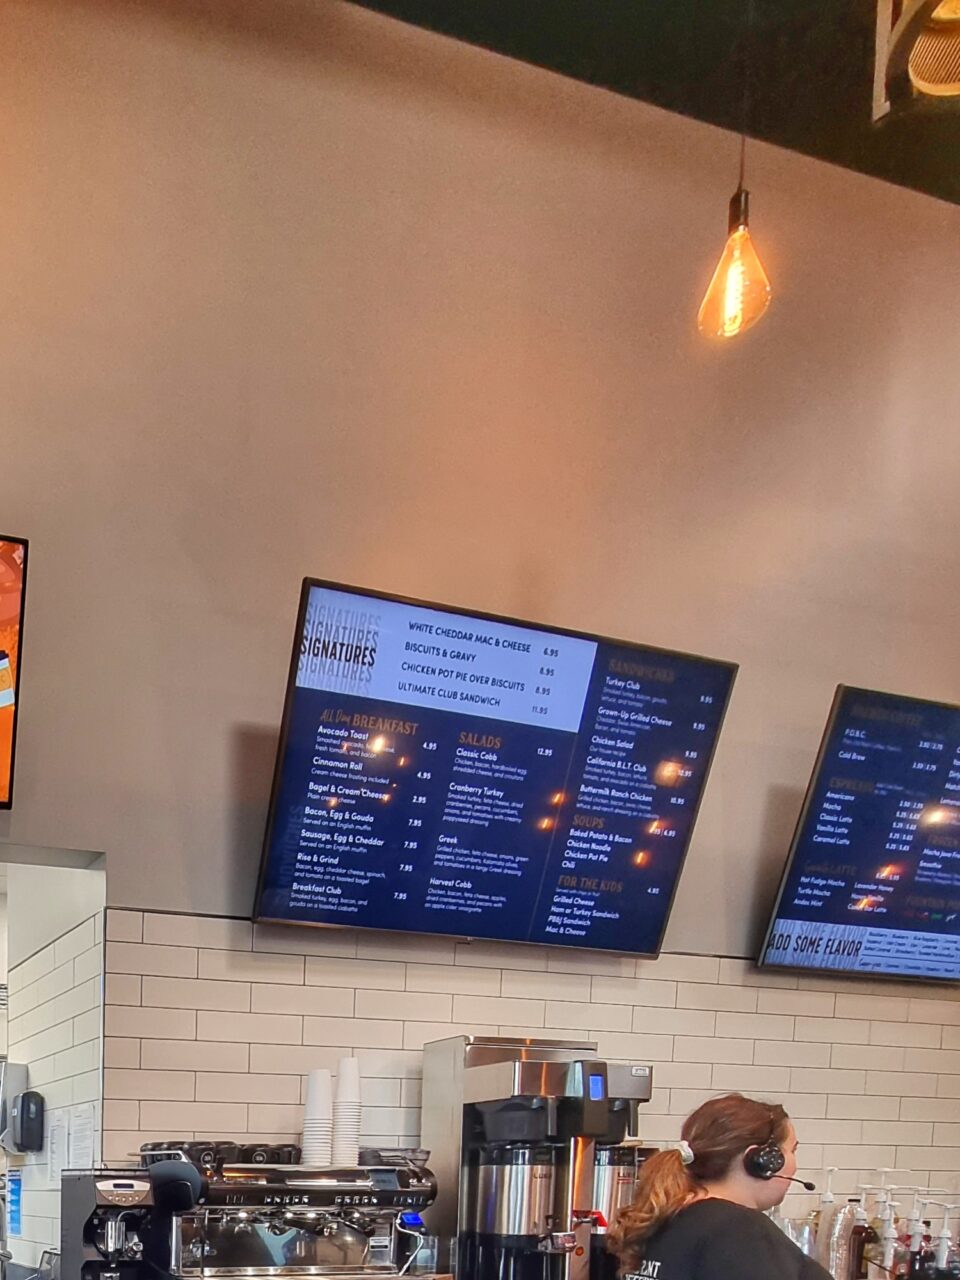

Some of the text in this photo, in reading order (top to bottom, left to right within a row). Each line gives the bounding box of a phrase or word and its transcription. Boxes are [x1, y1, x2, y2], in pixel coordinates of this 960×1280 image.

[304, 619, 379, 648] SIGNATURES
[409, 621, 559, 657] WHITE CHEDDAR MAC & CHEESE 6.95
[300, 636, 376, 667] SIGNATURES
[405, 641, 441, 656] BISCUITS
[442, 649, 447, 657] &
[449, 650, 476, 662] GRAVY
[298, 654, 373, 682] SIGNATURES
[402, 662, 437, 676] CHICKEN
[438, 668, 454, 679] POT
[456, 671, 468, 682] PIE
[469, 674, 490, 685] OVER
[491, 677, 526, 691] BISCUITS
[606, 676, 640, 690] Turkey Club
[398, 681, 436, 696] ULTIMATE
[437, 688, 458, 700] CLUB
[459, 693, 501, 707] SANDWICH
[598, 706, 629, 720] Grown-Up
[630, 712, 650, 723] Grilled
[651, 716, 672, 727] Cheese
[352, 714, 419, 736] BREAKFAST
[318, 725, 437, 750] Avocado Toast 4.95
[459, 731, 502, 749] SALADS
[592, 735, 634, 749] Chicken Salad
[456, 748, 552, 761] Classic Cobb 12.95
[838, 751, 851, 759] Cold
[313, 756, 431, 780] Cinnamon Roll 4.95
[586, 756, 647, 772] California Club
[309, 782, 329, 793] Bagel
[337, 786, 360, 796] Cream
[449, 782, 504, 798] Cranberry Turkey
[580, 784, 652, 802] Buttermilk Ranch Chicken
[826, 791, 855, 801] Americano
[305, 806, 422, 827] Bacon, Egg & Gouda 7.95
[573, 814, 605, 829] SOUPS
[819, 813, 838, 822] Classic
[569, 828, 588, 839] Baked
[589, 831, 608, 840] Potato
[614, 834, 632, 843] Bacon
[816, 824, 834, 832] Vanilla
[301, 829, 332, 842] Sausage,
[333, 832, 346, 843] Egg
[355, 835, 384, 846] Cheddar
[404, 841, 418, 849] 7.95
[439, 834, 457, 844] Greek
[567, 839, 611, 852] Chicken Noodle
[813, 834, 836, 844] Caramel
[297, 852, 312, 862] Rise
[320, 856, 339, 865] Grind
[400, 864, 413, 872] 7.95
[564, 850, 608, 862] Chicken Pot Pie
[562, 860, 576, 869] Chili
[430, 877, 472, 888] Harvest Cobb
[558, 875, 577, 887] FOR
[580, 877, 599, 890] THE
[600, 880, 624, 893] KIDS
[292, 882, 407, 900] Breakfast Club 7.95
[553, 895, 595, 906] Grilled Cheese
[563, 917, 591, 926] Sandwich
[573, 908, 591, 917] Turkey
[592, 910, 620, 919] Sandwich
[545, 925, 559, 933] Mac
[565, 927, 586, 936] Cheese
[769, 932, 791, 951] ADD
[793, 935, 823, 953] SOME
[824, 939, 863, 957] FLAVOR
